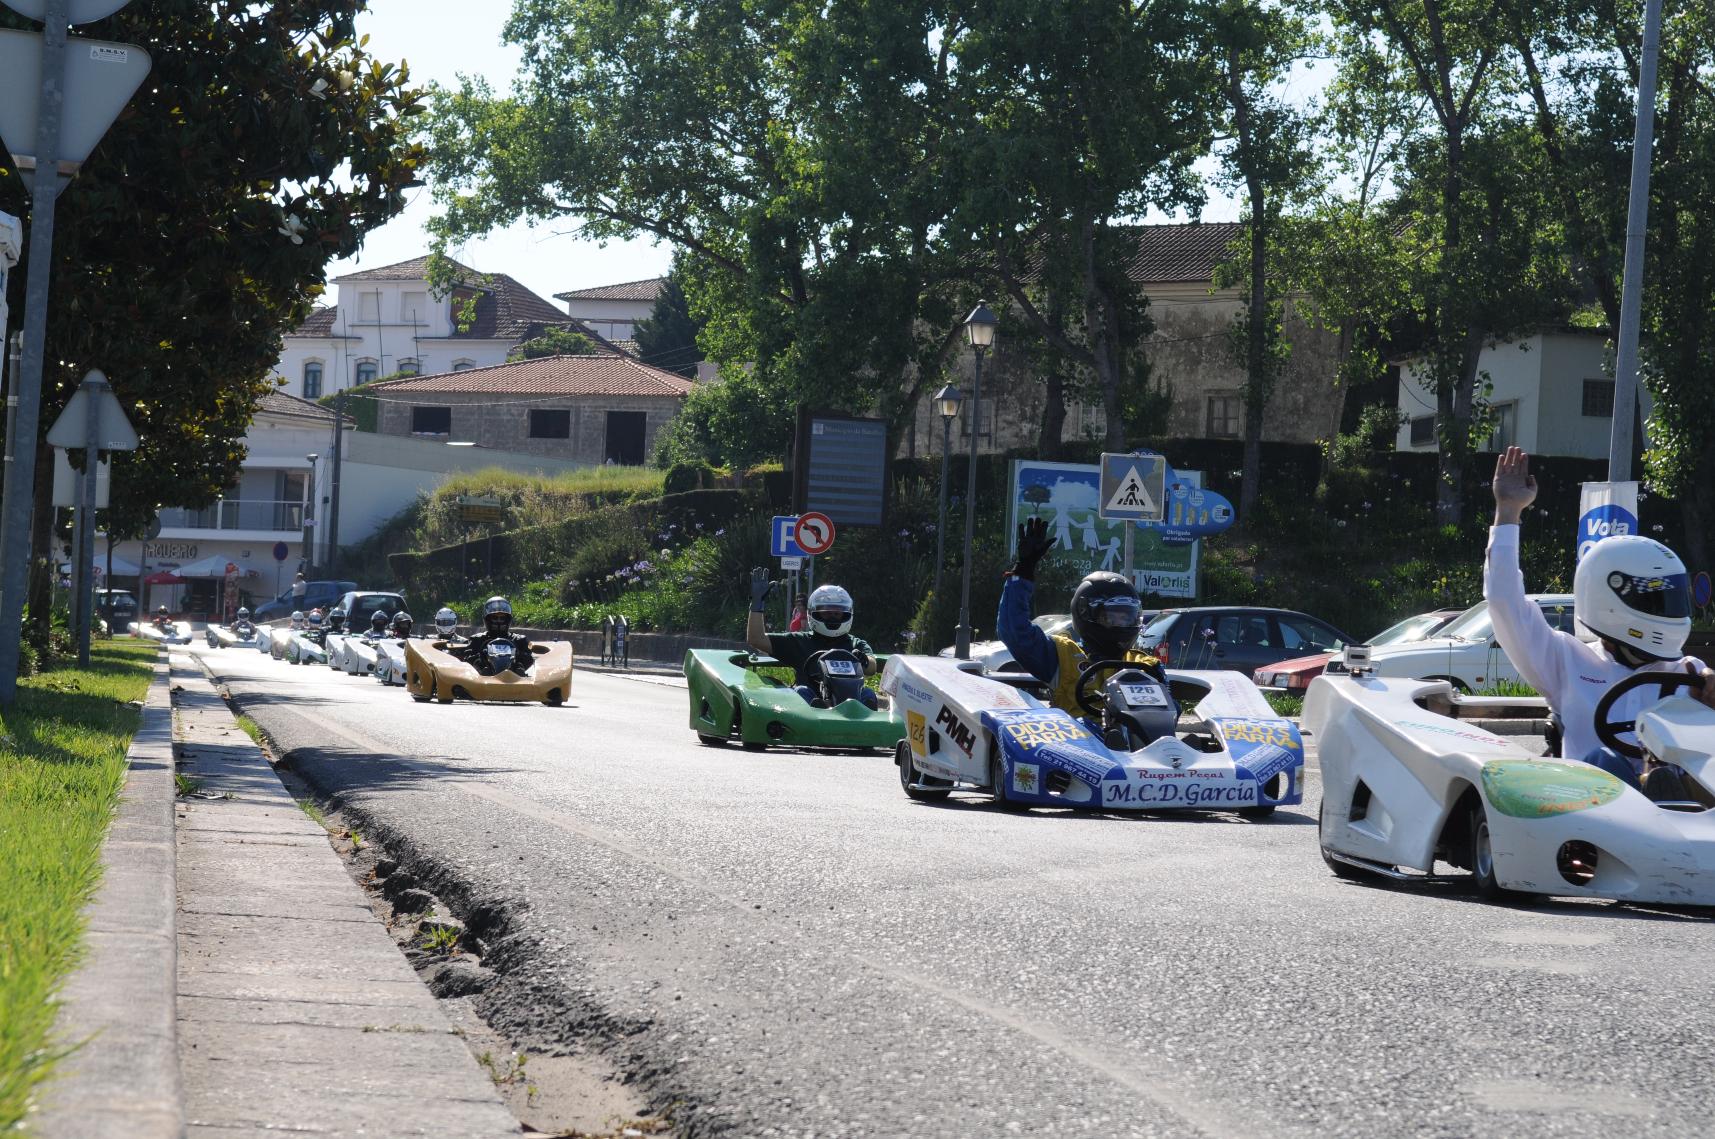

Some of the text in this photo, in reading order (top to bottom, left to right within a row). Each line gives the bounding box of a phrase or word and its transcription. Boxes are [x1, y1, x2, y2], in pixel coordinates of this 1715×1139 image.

[780, 520, 796, 552] P
[1586, 518, 1630, 536] Vota
[1126, 686, 1155, 694] 126
[910, 722, 926, 744] 126
[936, 703, 976, 751] PMH
[1136, 769, 1186, 781] Rugem
